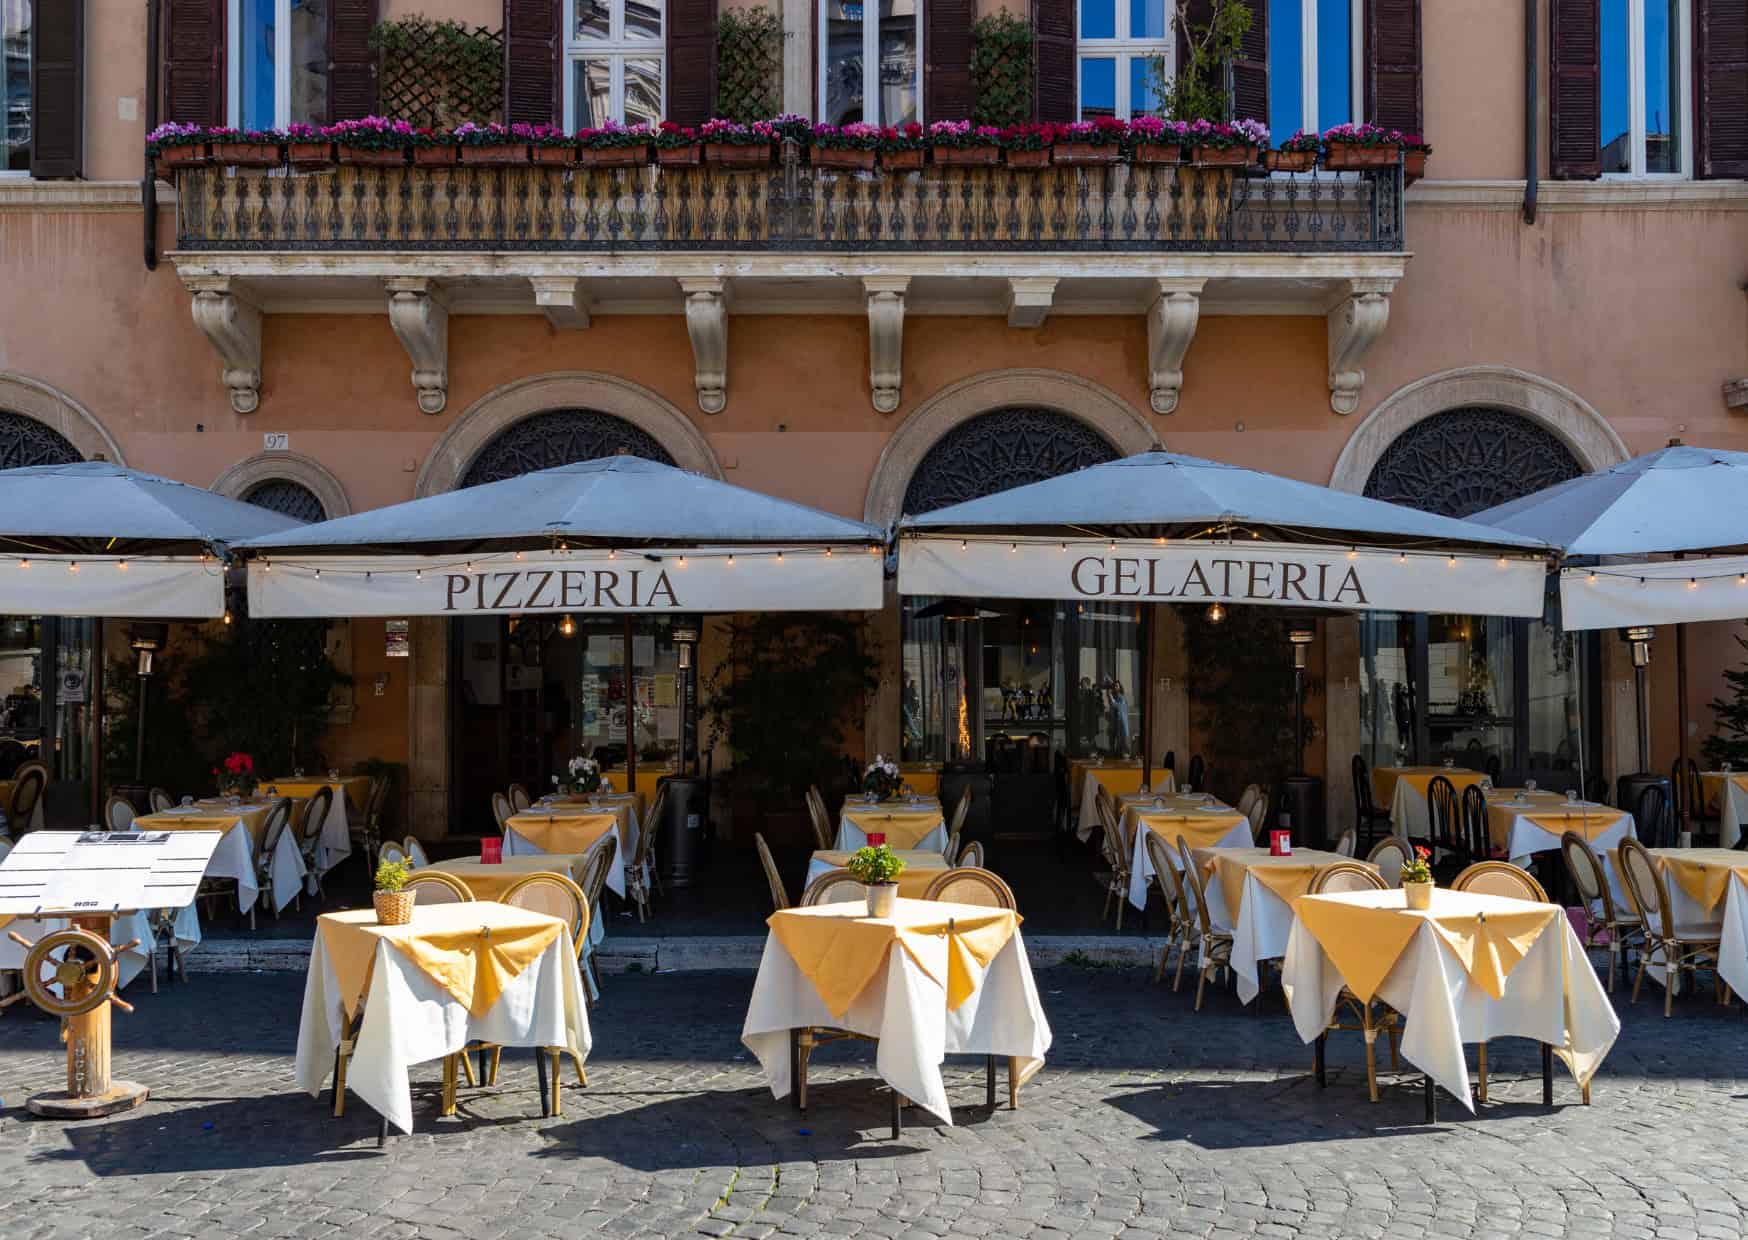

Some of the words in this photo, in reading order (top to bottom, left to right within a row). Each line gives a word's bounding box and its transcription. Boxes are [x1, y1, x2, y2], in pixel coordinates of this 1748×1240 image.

[266, 434, 287, 450] 97
[443, 569, 681, 610] PIZZERIA
[1071, 556, 1369, 604] GELATERIA
